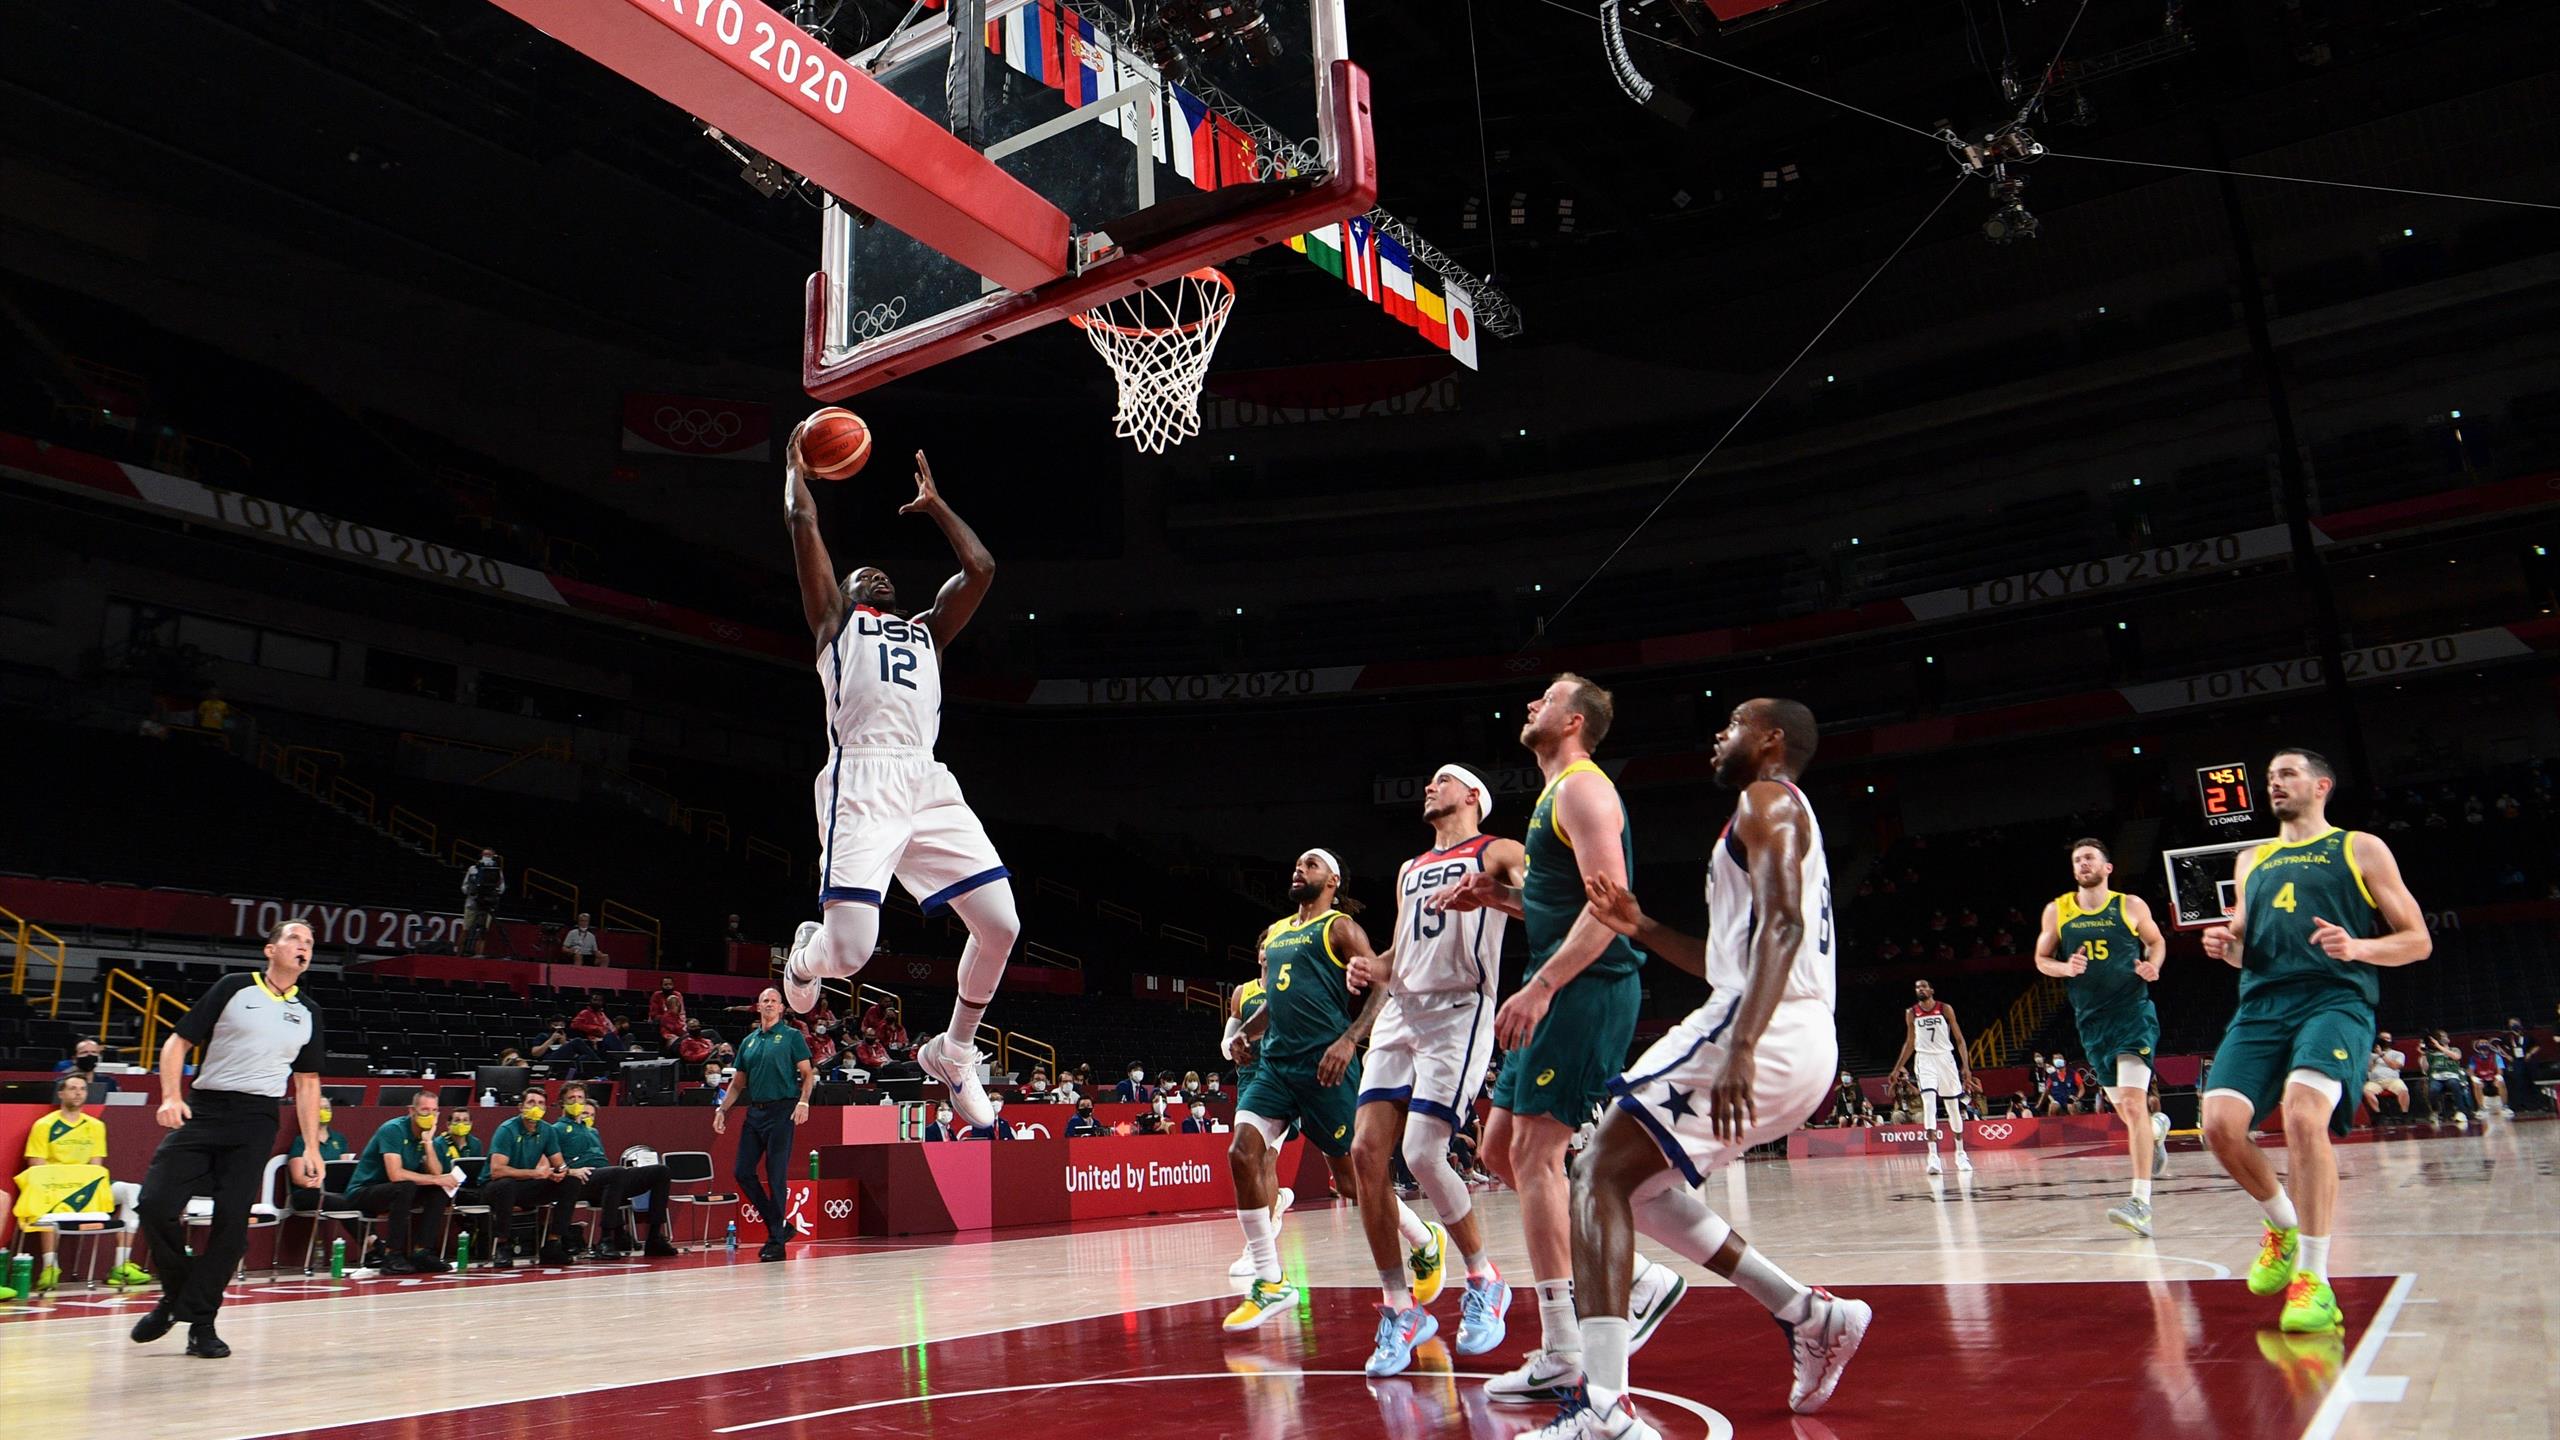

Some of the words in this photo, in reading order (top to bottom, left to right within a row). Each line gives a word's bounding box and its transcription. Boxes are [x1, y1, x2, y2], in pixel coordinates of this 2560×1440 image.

[749, 22, 848, 114] 2020
[209, 489, 377, 558] TOKYO
[391, 532, 506, 590] 2020
[1960, 559, 2110, 610] TOKYO
[2123, 534, 2241, 582] 2020
[858, 616, 931, 650] USA
[878, 643, 918, 690] 12
[2178, 658, 2323, 702] TOKYO
[2342, 637, 2457, 678] 2020
[1083, 673, 1209, 703] TOKYO
[1216, 670, 1314, 698] 2020
[2206, 786, 2248, 813] 21
[2219, 814, 2252, 825] OMEGA
[2261, 853, 2328, 872] AUSTRALIA
[1404, 862, 1467, 896] USA
[2272, 882, 2297, 913] 4
[2071, 919, 2113, 929] AUSTRALIA
[1270, 935, 1311, 949] AUSTRALIA
[2083, 940, 2109, 961] 15
[1276, 963, 1292, 992] 5
[1917, 1017, 1942, 1027] USA
[1926, 1027, 1936, 1043] 7
[1881, 1130, 1916, 1143] TOKYO
[1065, 1164, 1120, 1193] United
[1126, 1162, 1145, 1193] by
[1149, 1159, 1211, 1187] Emotion
